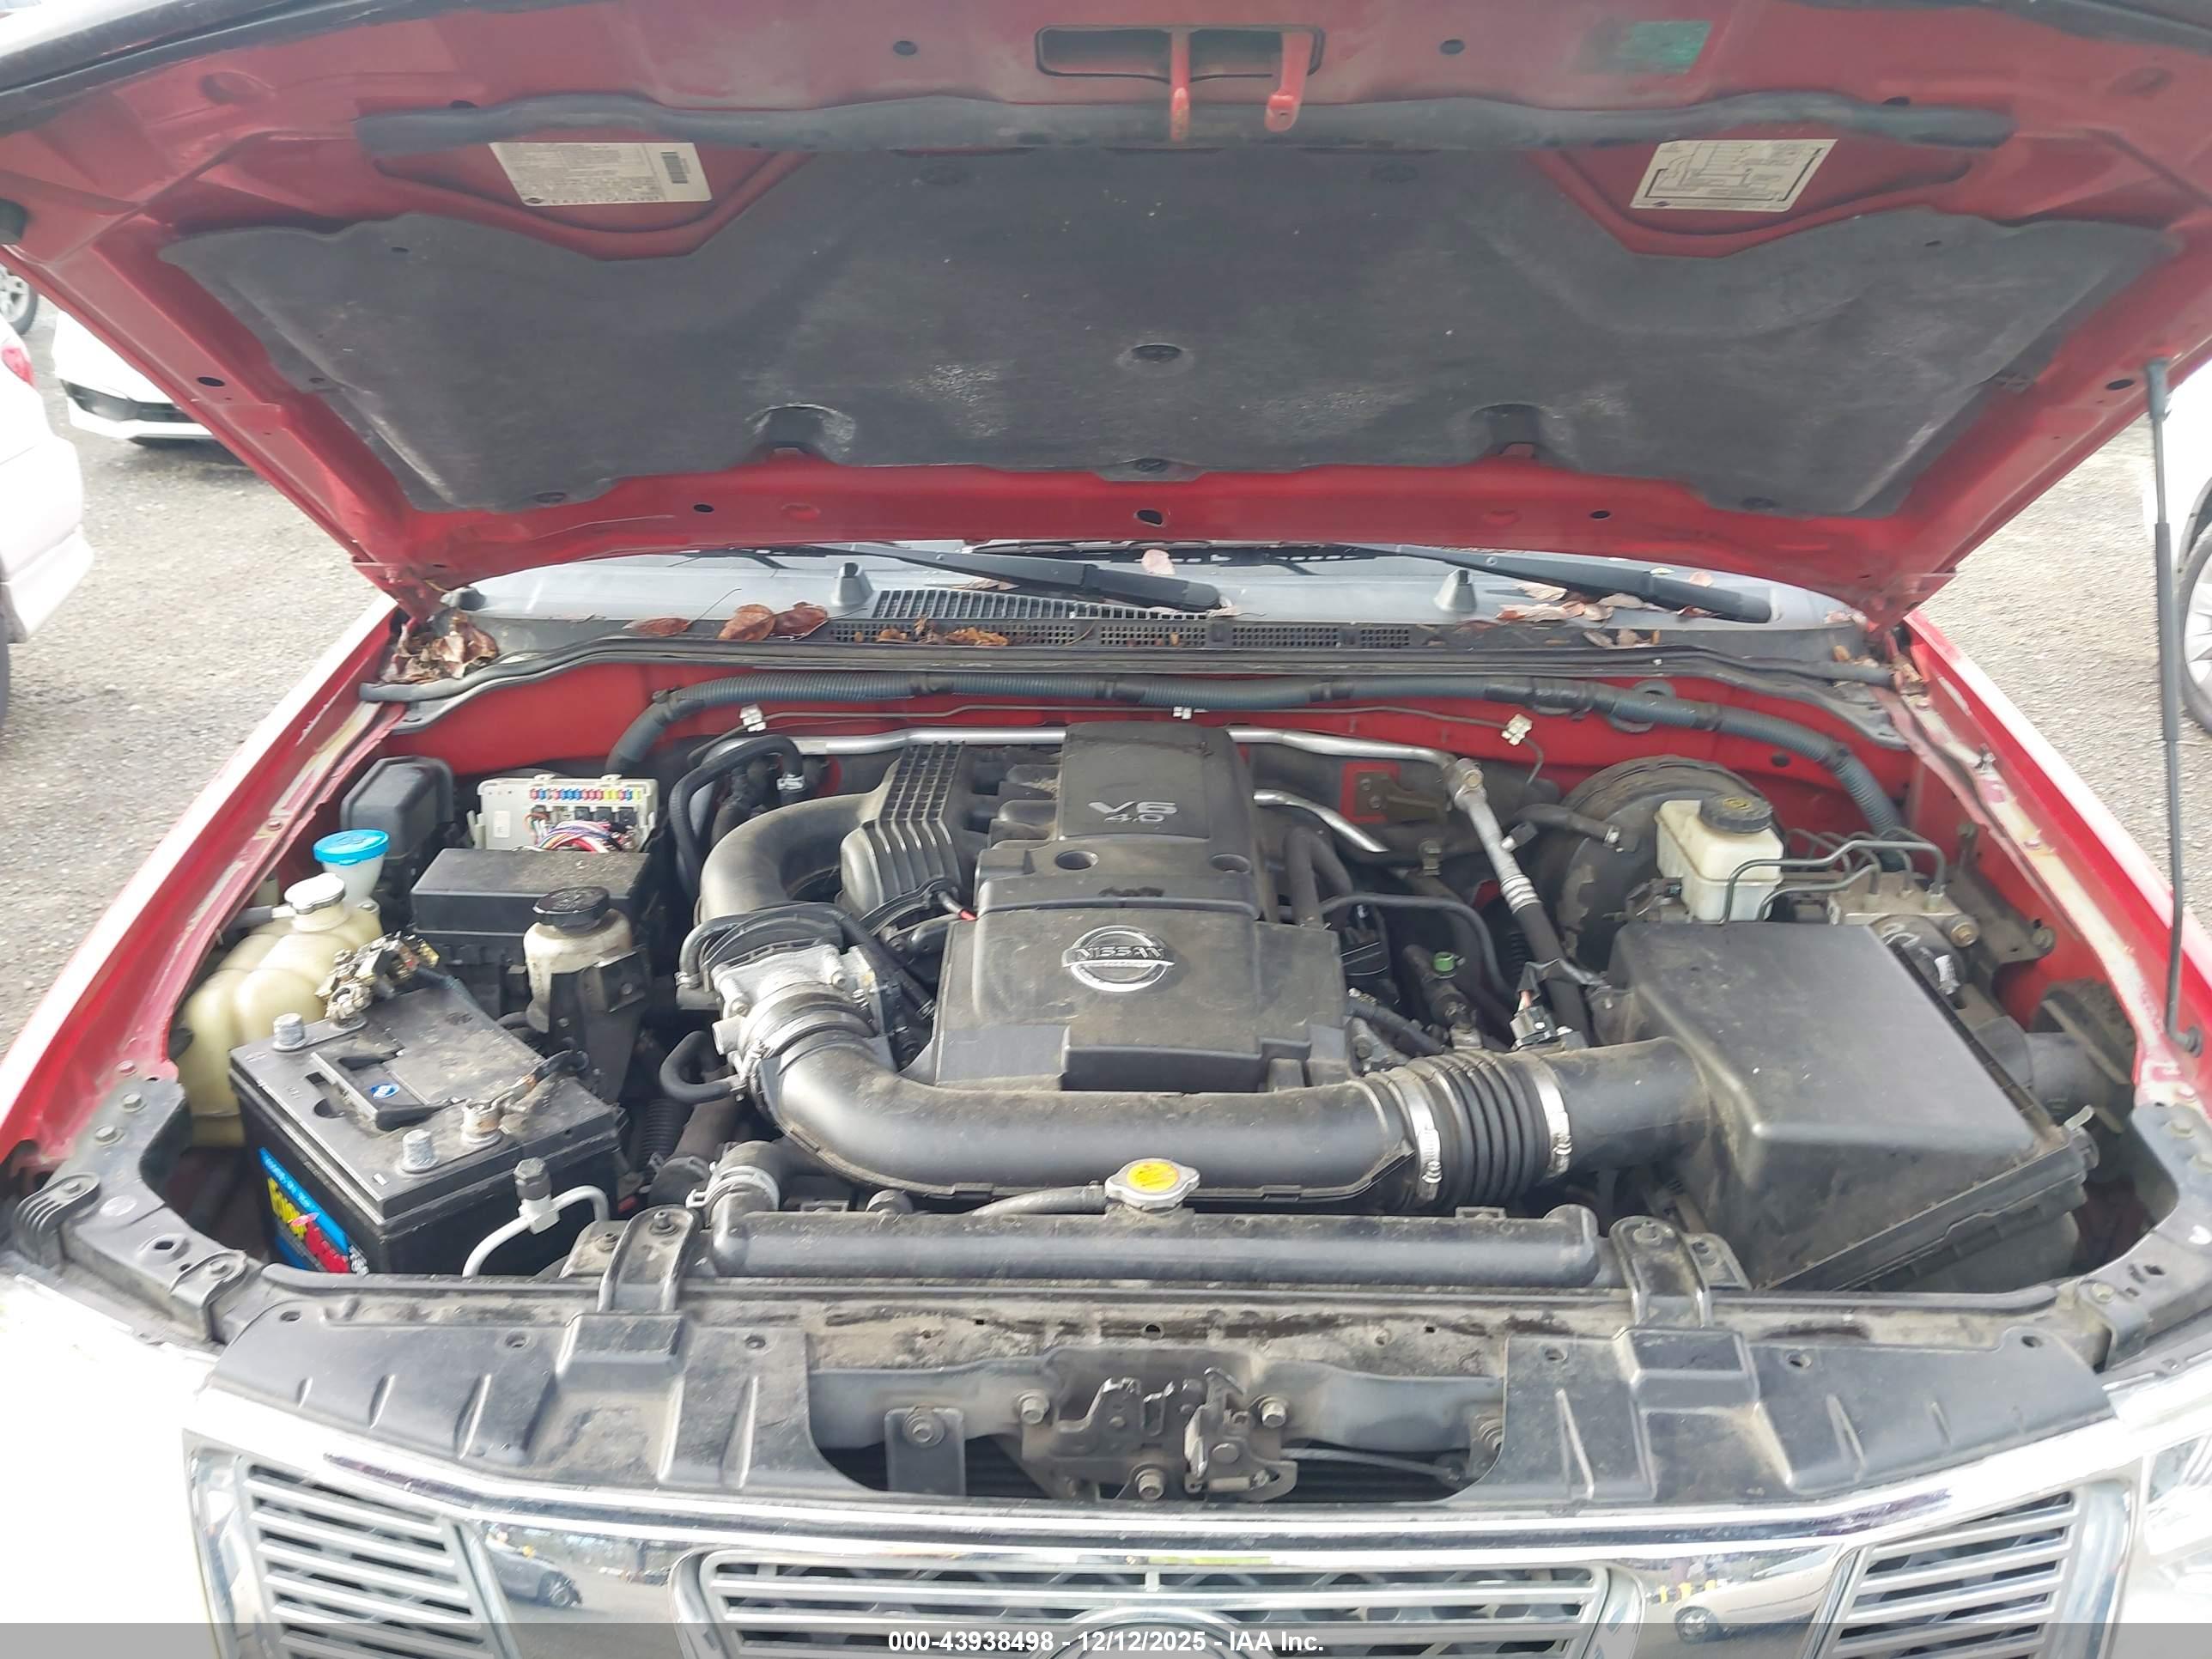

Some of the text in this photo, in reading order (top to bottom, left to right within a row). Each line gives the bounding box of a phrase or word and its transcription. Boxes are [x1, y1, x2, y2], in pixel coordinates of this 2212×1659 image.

[1088, 800, 1178, 815] V6
[1104, 813, 1165, 823] 4.0
[1075, 945, 1165, 961] NISSAN
